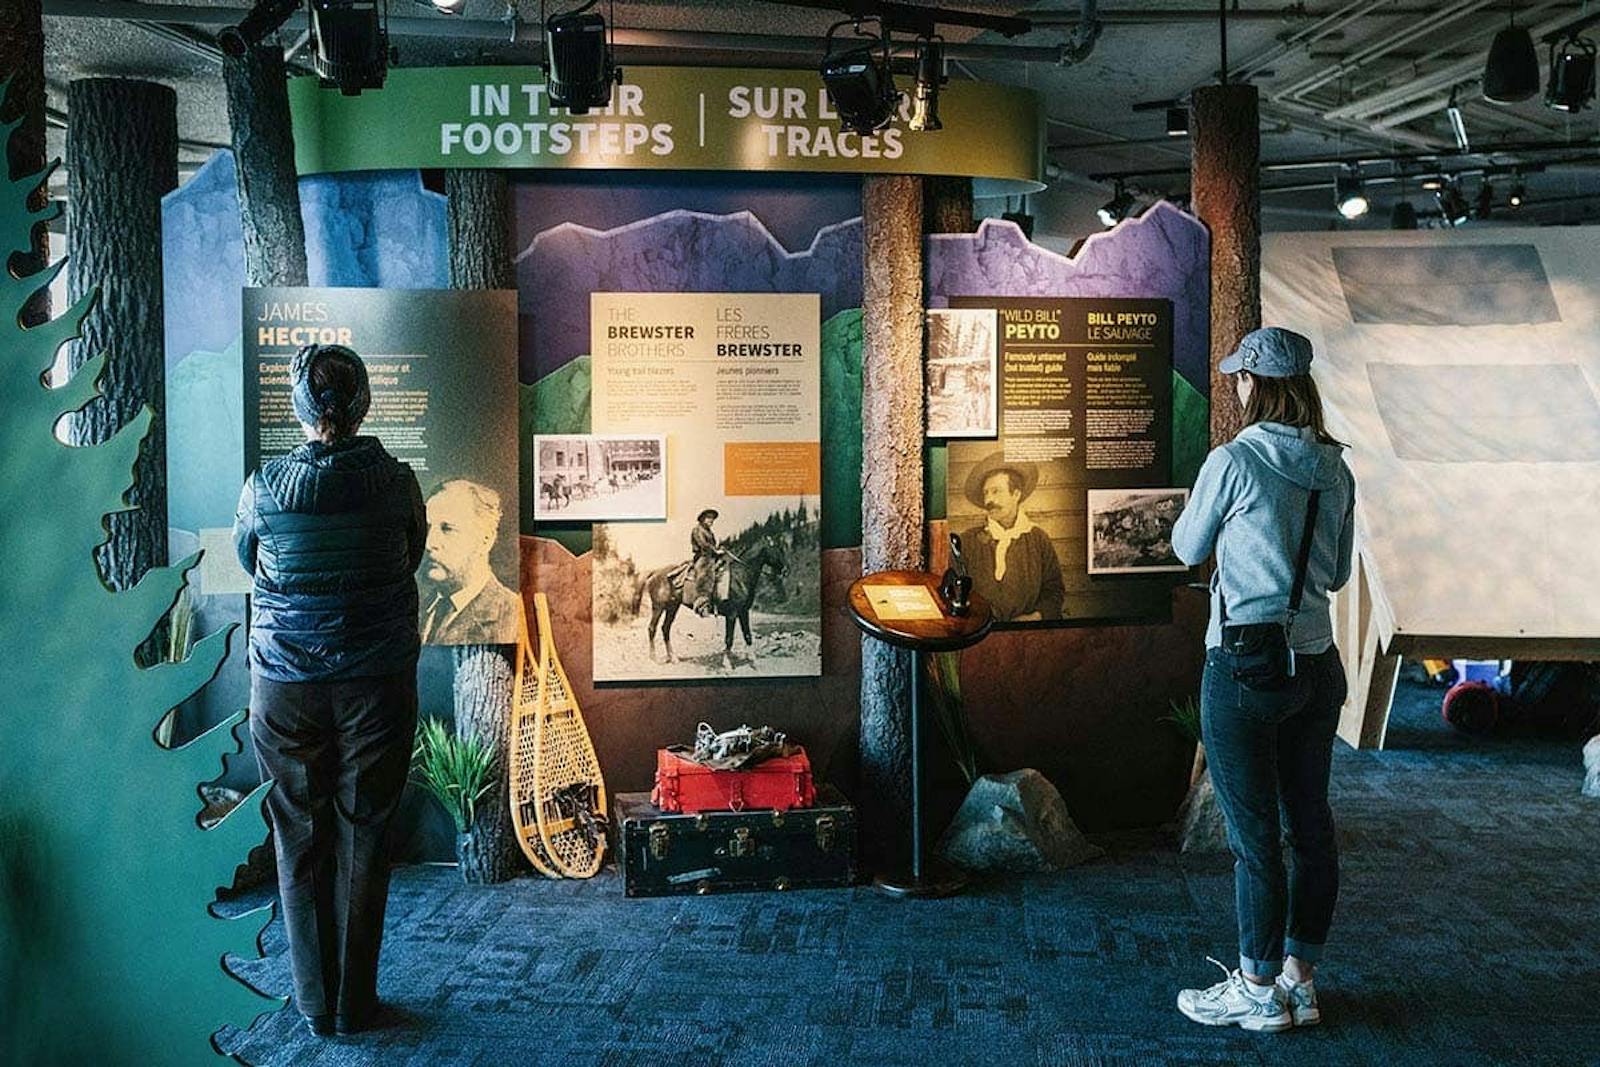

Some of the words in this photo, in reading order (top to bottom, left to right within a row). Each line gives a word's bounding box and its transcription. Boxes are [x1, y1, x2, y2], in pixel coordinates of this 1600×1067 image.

[470, 84, 510, 116] IN
[521, 84, 646, 117] TIR
[728, 86, 807, 120] SUR
[440, 122, 675, 156] FOOTSTEPS
[761, 124, 905, 160] TRACES
[258, 302, 329, 322] JAMES
[608, 307, 635, 322] THE
[716, 307, 742, 322] LES
[1087, 312, 1115, 325] BILL
[1117, 313, 1158, 325] PEYTO
[257, 327, 353, 347] HECTOR
[607, 326, 695, 339] BREWSTER
[1005, 324, 1060, 340] PEYTO
[1087, 326, 1102, 340] LE
[1102, 327, 1153, 341] SAUVAGE
[608, 342, 685, 358] BROTHERS
[717, 344, 802, 357] BREWSTER
